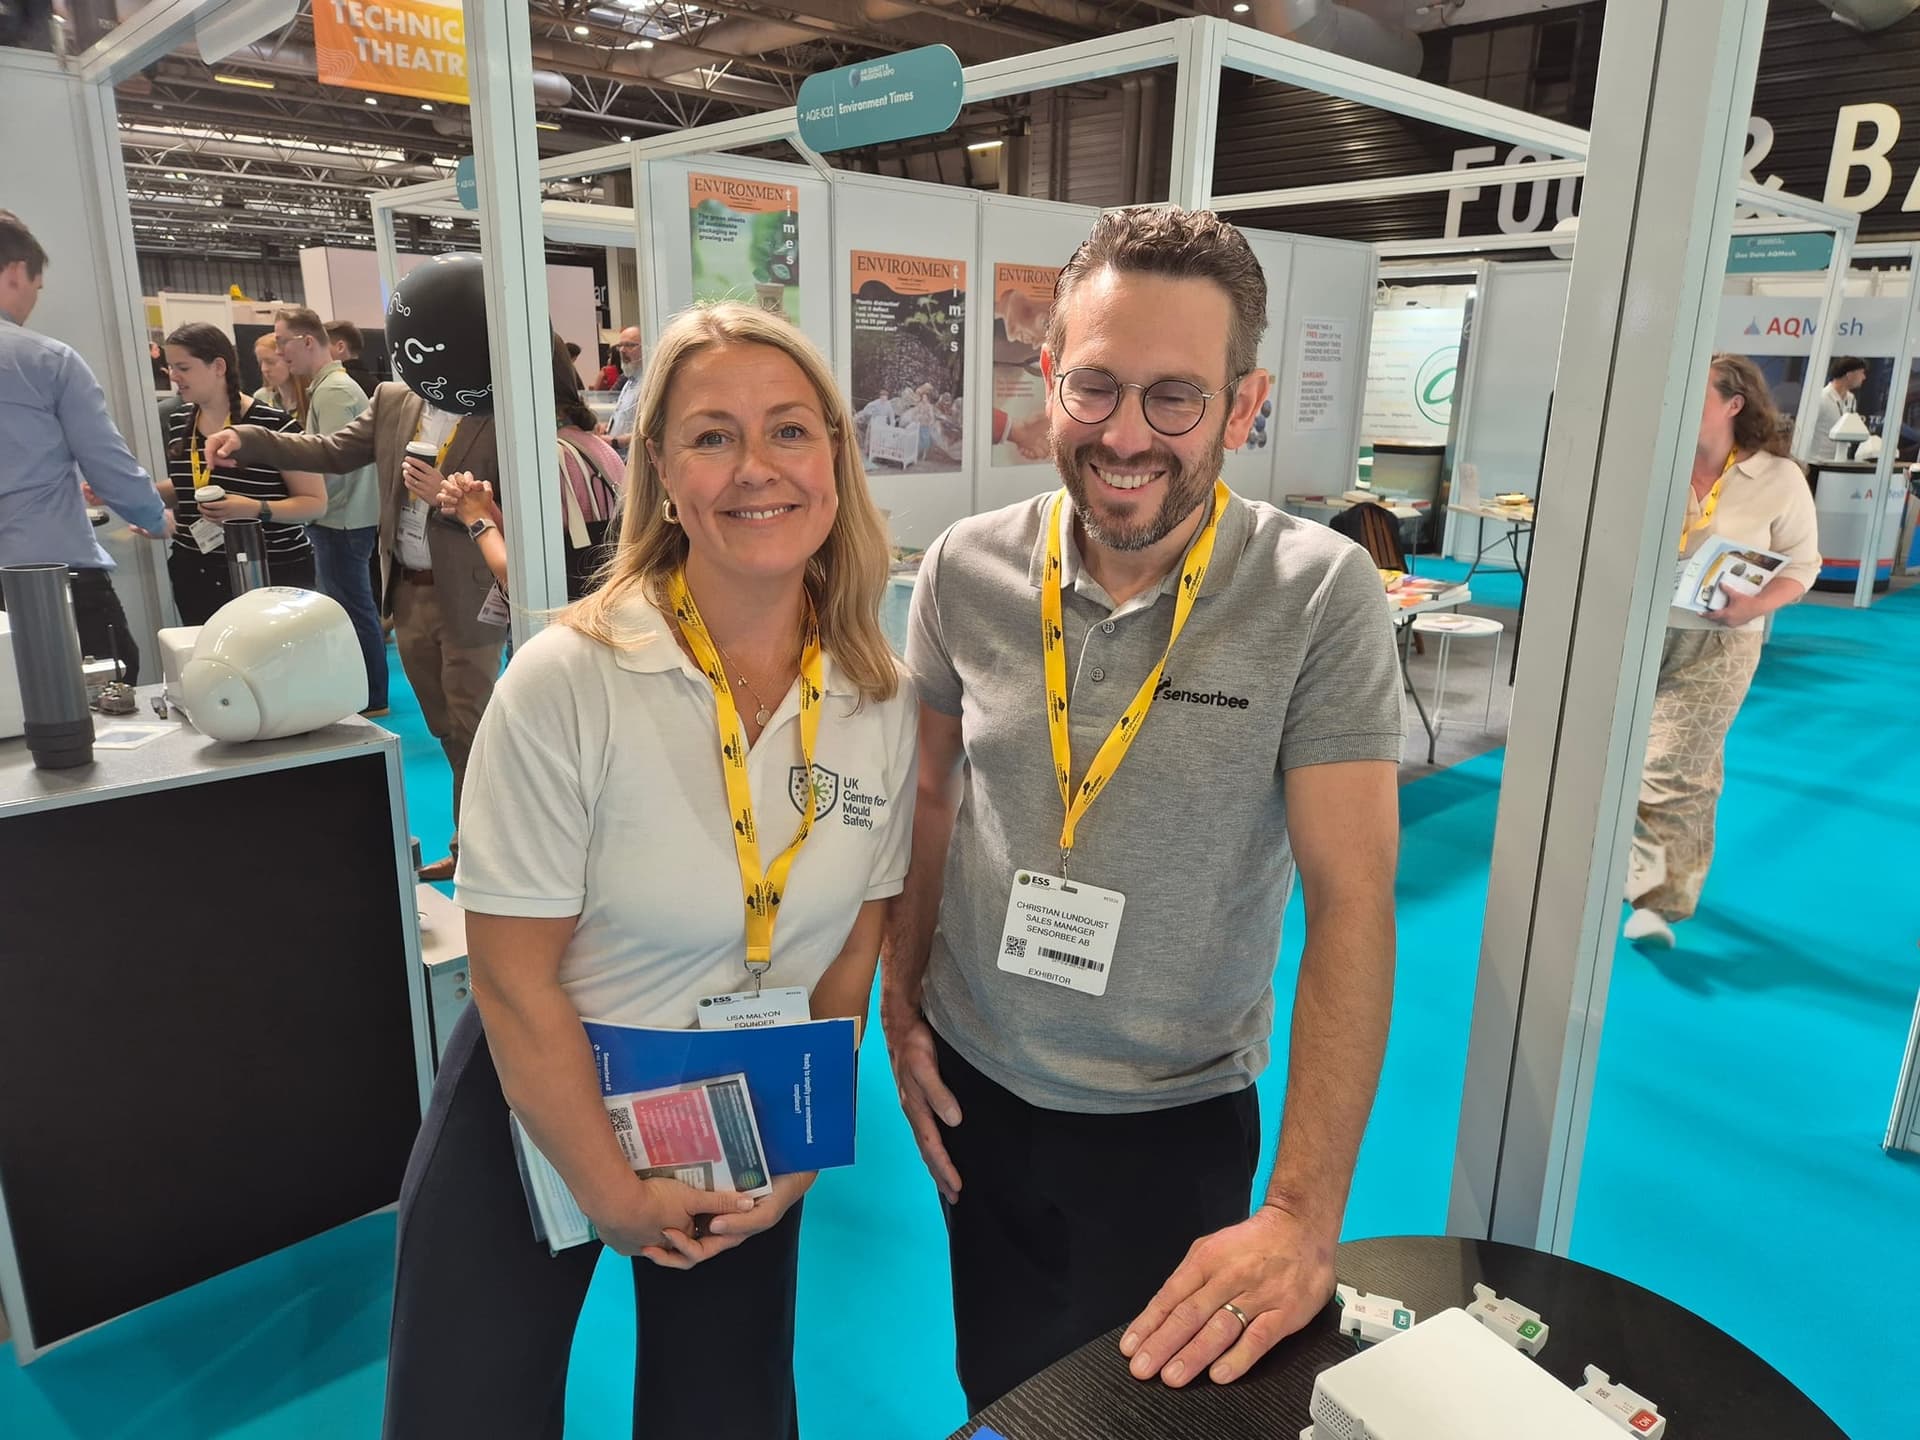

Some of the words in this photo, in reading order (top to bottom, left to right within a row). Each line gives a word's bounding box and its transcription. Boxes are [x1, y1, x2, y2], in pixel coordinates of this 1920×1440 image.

[331, 0, 465, 44] TECHNIC
[805, 106, 834, 122] AQE-K32
[839, 95, 888, 114] Environment
[889, 91, 914, 105] Times
[1823, 102, 1920, 214] B
[1766, 317, 1864, 339] AQMsh
[1162, 690, 1249, 709] sensorbee
[843, 776, 859, 790] UK
[843, 790, 873, 805] Centre
[873, 797, 887, 807] for
[843, 802, 871, 817] Mould
[843, 814, 873, 830] Safety
[1031, 876, 1050, 887] ESS
[1016, 900, 1060, 917] CHRISTIAN
[1061, 911, 1109, 929] LUNDQUIST
[1025, 913, 1052, 926] SALES
[1053, 920, 1095, 937] MANAGER
[1026, 924, 1077, 944] SENSORBEE
[1077, 937, 1090, 947] AB
[1028, 968, 1071, 985] EXHIBITOR
[713, 995, 732, 1003] ESS
[726, 1013, 745, 1021] LISA
[746, 1010, 781, 1020] MALYON
[734, 1019, 775, 1029] FOUNDER
